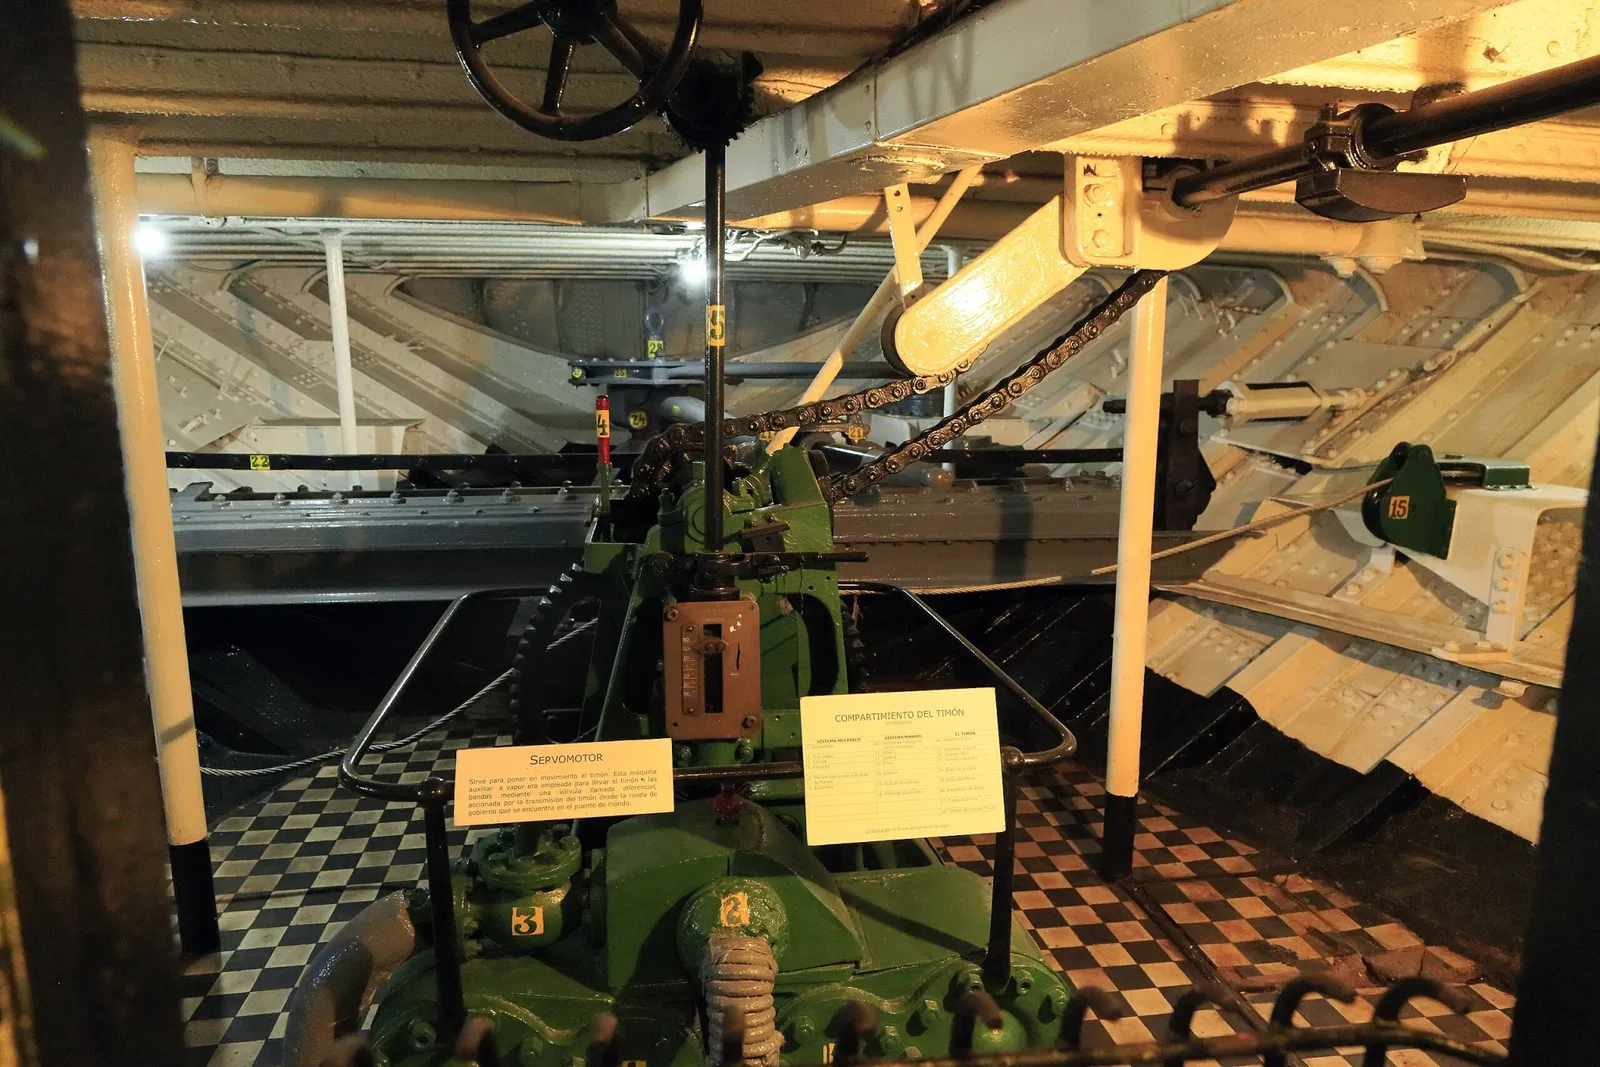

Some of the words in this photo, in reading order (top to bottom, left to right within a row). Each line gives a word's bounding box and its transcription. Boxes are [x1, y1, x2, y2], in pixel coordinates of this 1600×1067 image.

[710, 310, 724, 339] 5
[596, 414, 607, 435] 4
[251, 456, 269, 467] 22
[1390, 500, 1407, 518] 15
[834, 710, 914, 723] COMPARTIMIENTO
[917, 710, 934, 718] DEL
[936, 706, 965, 717] TIMÓN
[530, 753, 603, 765] SERVOMOTOR
[541, 781, 572, 789] empleada
[525, 796, 563, 805] transmisión
[468, 808, 496, 817] gobierno
[722, 896, 742, 924] 2
[514, 907, 538, 935] 3
